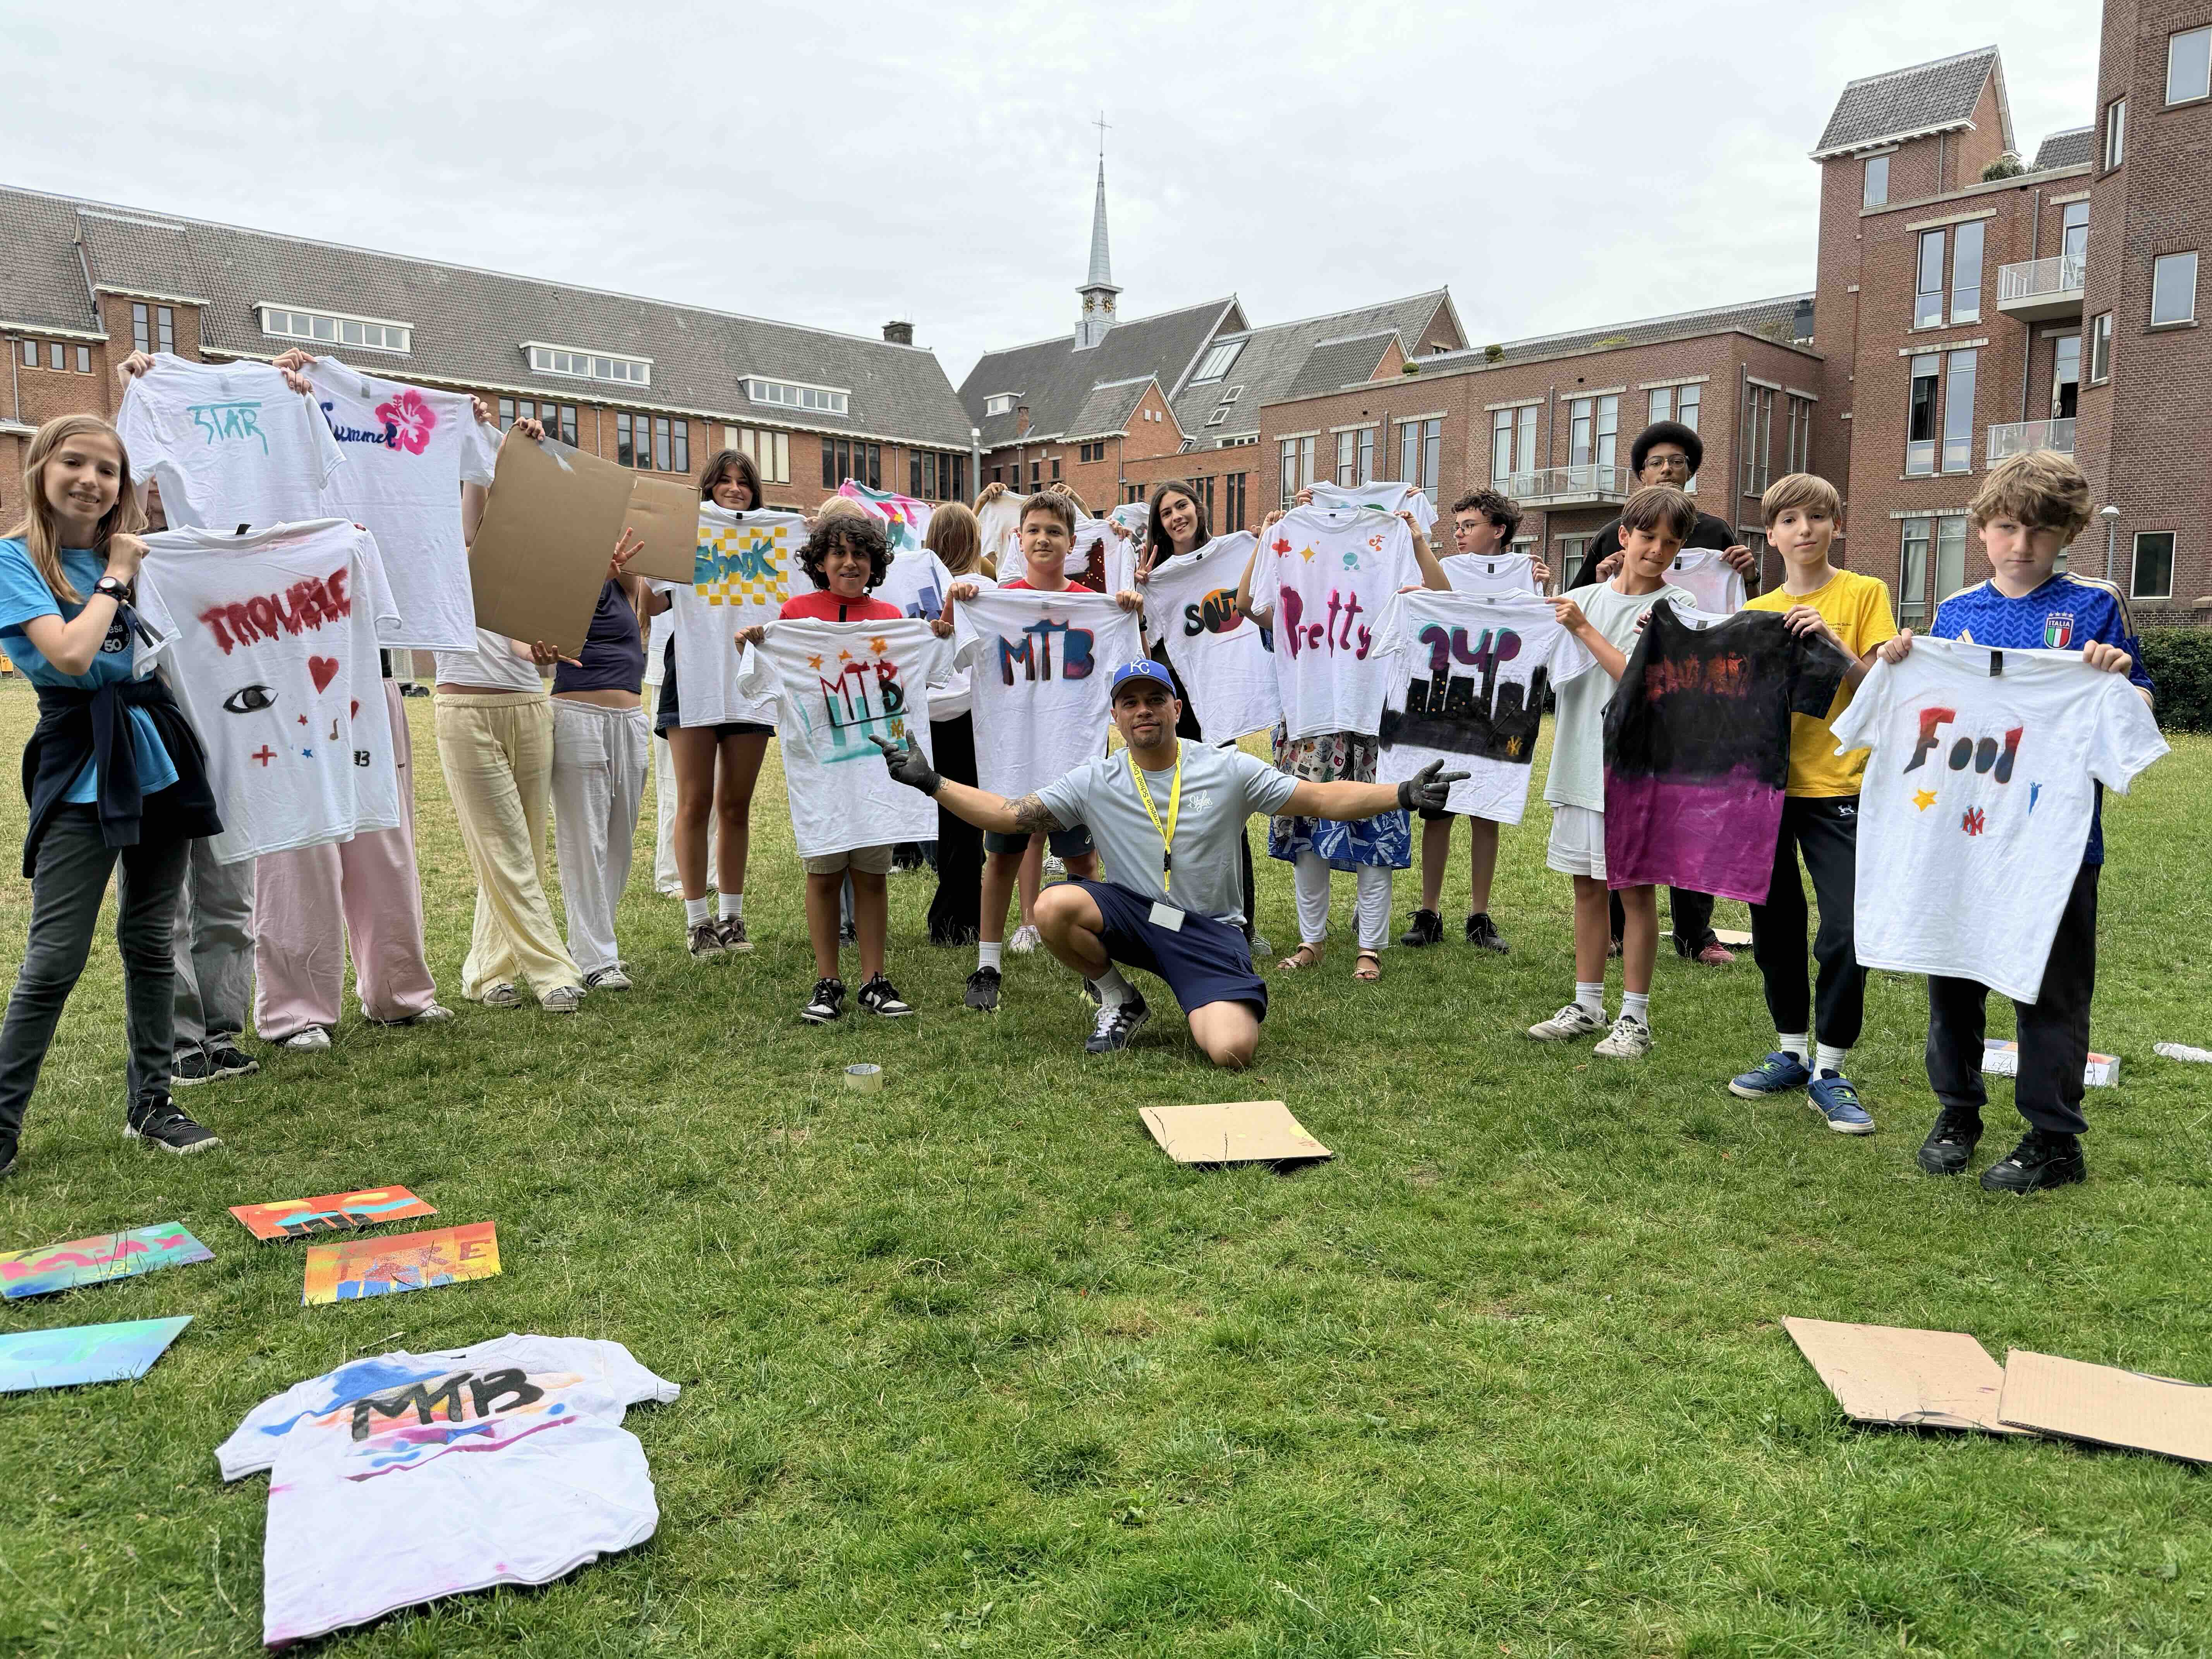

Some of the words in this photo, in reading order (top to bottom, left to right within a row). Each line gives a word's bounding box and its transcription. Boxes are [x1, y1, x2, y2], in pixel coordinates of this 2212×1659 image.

[186, 402, 269, 456] STAR
[104, 638, 122, 652] 50
[1279, 586, 1372, 661] Pretty
[998, 620, 1094, 686] MTB
[1130, 659, 1150, 674] KC
[819, 659, 908, 727] MTB
[1136, 776, 1149, 798] School
[1186, 790, 1213, 812] Styles
[352, 1368, 544, 1441] MTB
